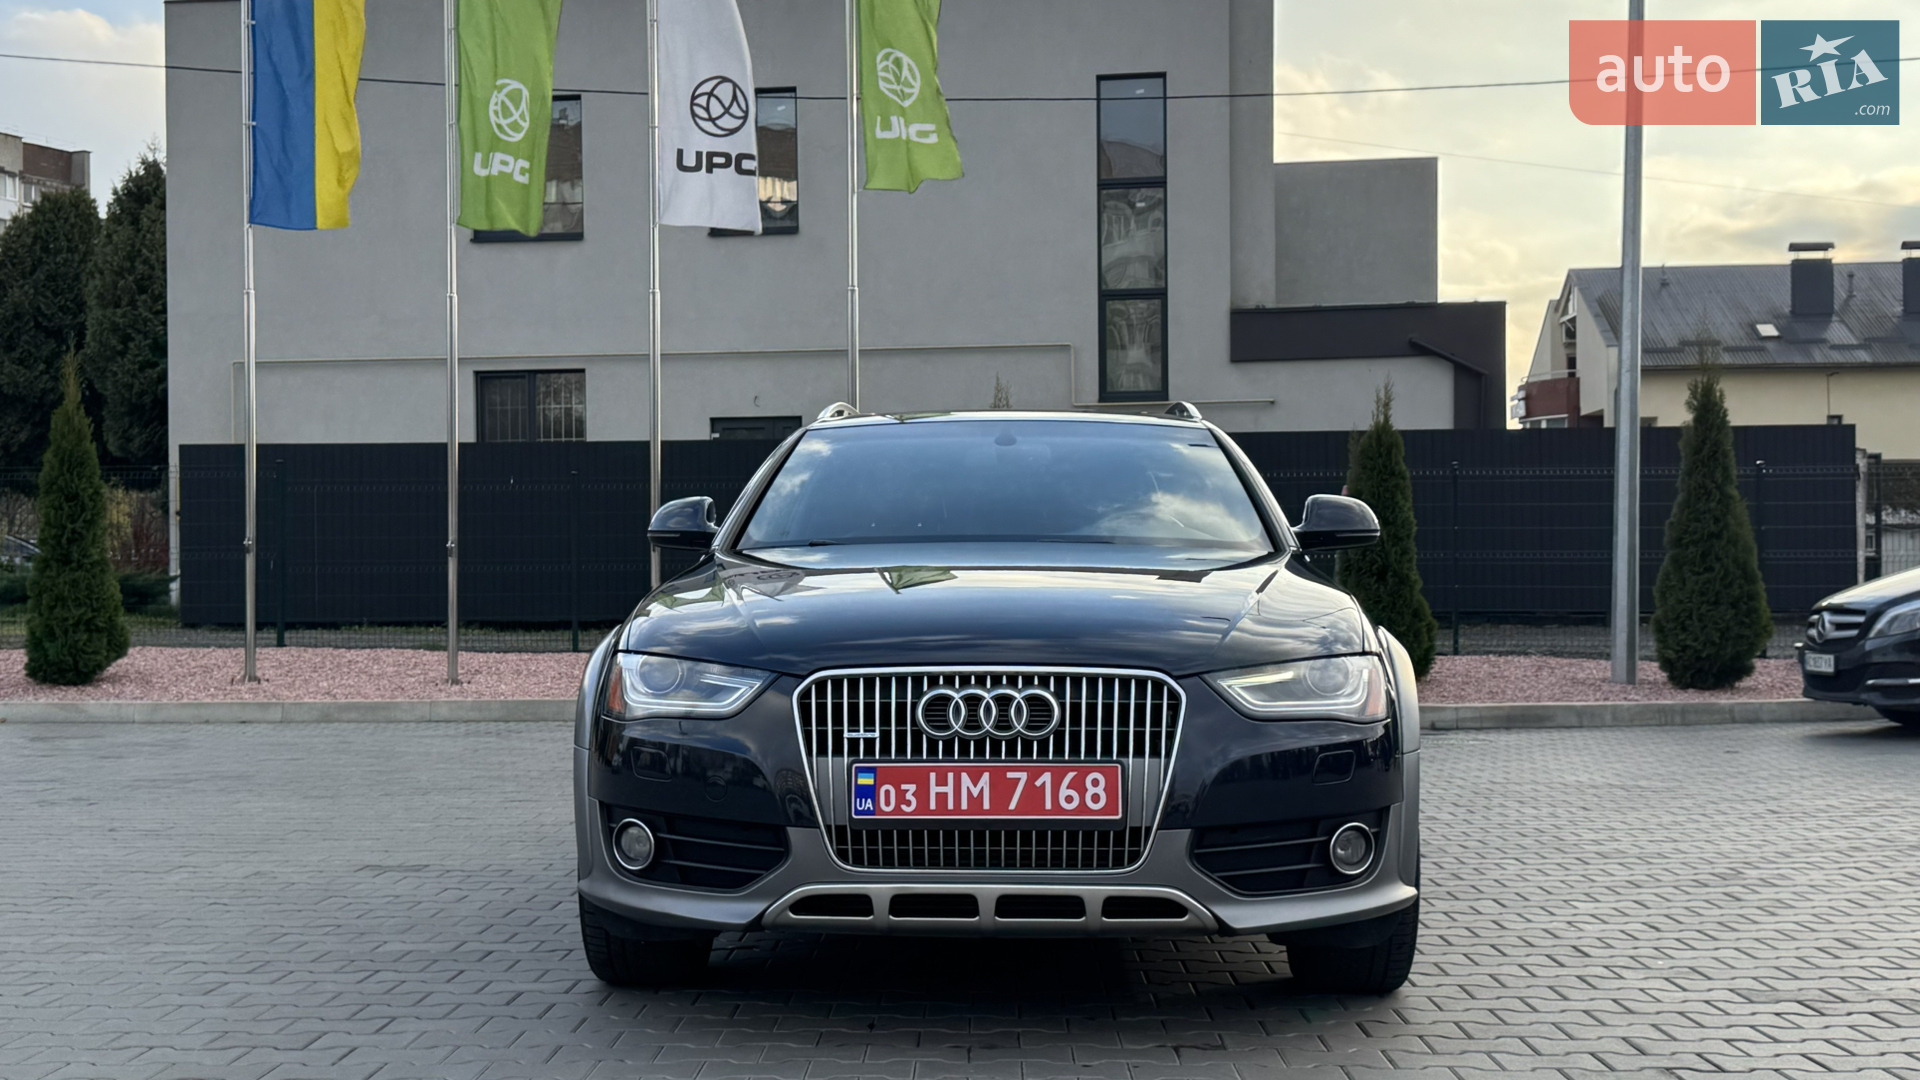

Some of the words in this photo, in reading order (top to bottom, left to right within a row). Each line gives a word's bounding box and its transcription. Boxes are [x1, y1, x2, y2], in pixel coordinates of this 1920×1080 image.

[856, 798, 874, 811] UA
[879, 784, 917, 812] 03
[929, 772, 990, 810] HM
[1006, 772, 1107, 810] 7168
